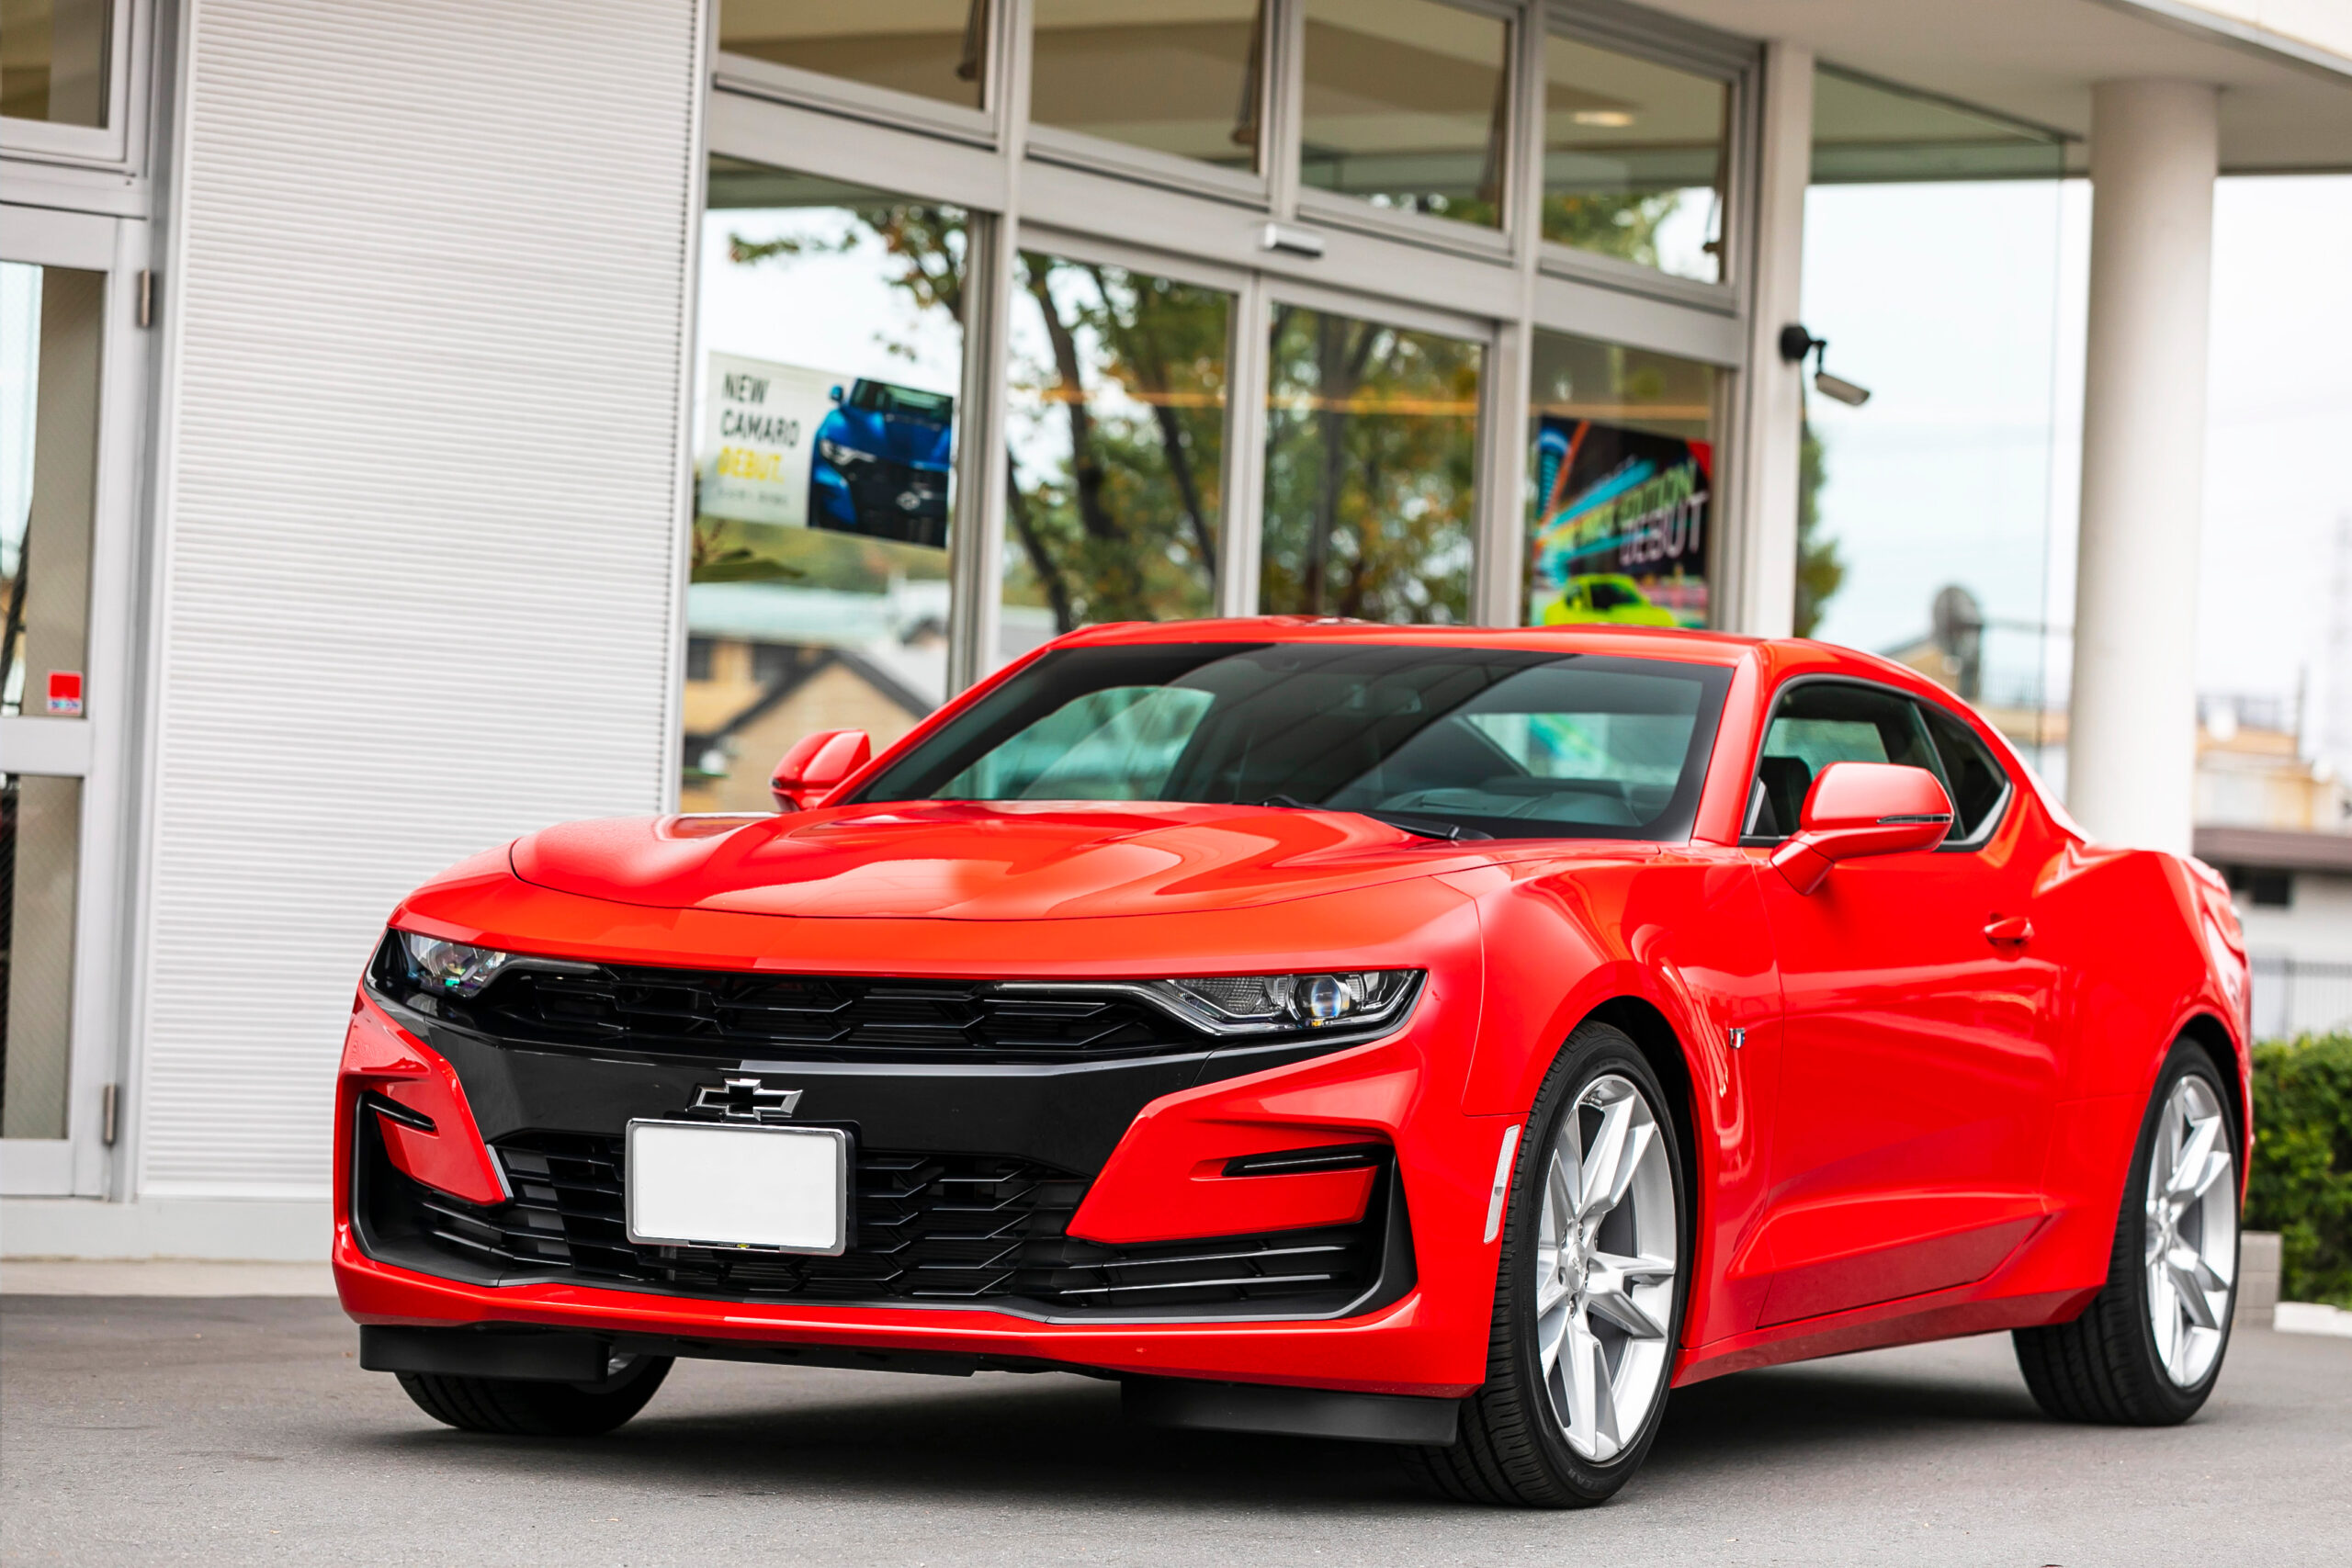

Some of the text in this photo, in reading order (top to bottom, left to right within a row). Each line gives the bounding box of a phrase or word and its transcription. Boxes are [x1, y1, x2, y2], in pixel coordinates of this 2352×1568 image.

[722, 372, 770, 404] NEW
[720, 410, 801, 448] CAMARO
[1619, 491, 1710, 565] DEBUT
